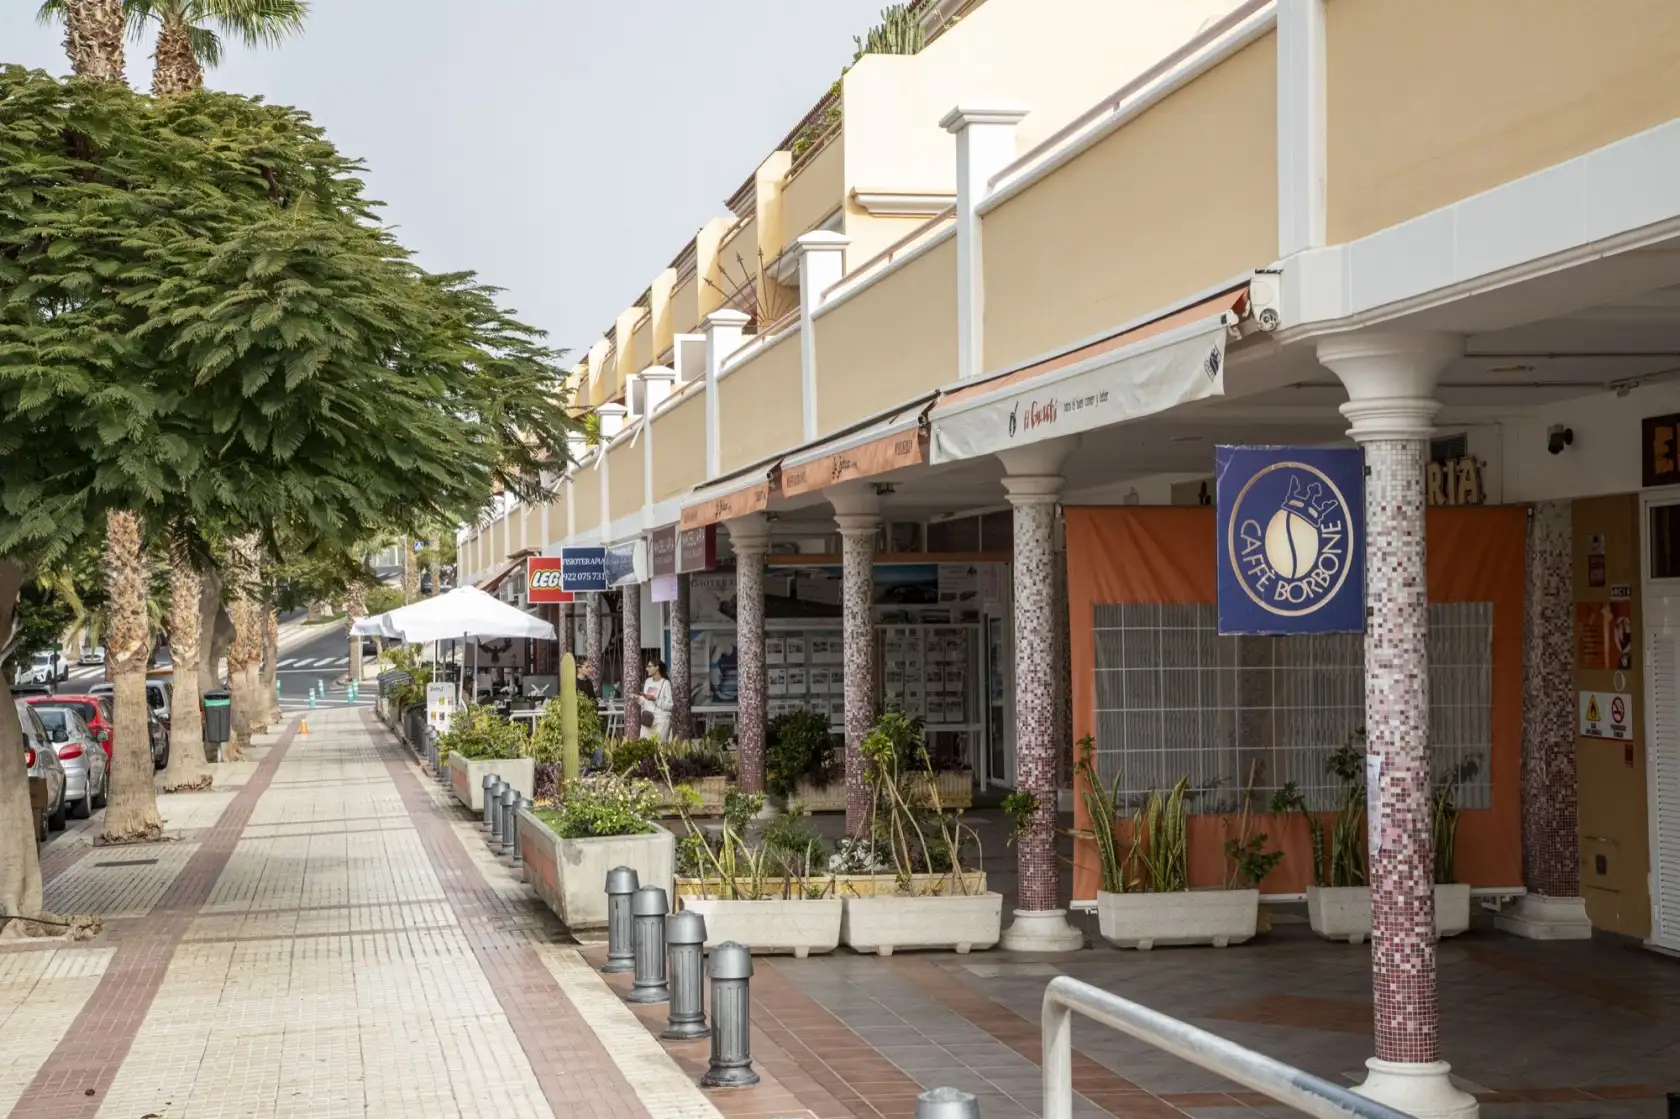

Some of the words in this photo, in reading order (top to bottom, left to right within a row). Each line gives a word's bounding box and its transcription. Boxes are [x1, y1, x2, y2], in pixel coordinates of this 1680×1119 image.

[1653, 424, 1680, 476] E
[1427, 456, 1480, 505] RIA
[532, 571, 563, 588] LEG
[563, 572, 577, 581] 922
[577, 572, 591, 581] 075
[592, 571, 605, 581] 731
[1274, 520, 1342, 603] BORBONE
